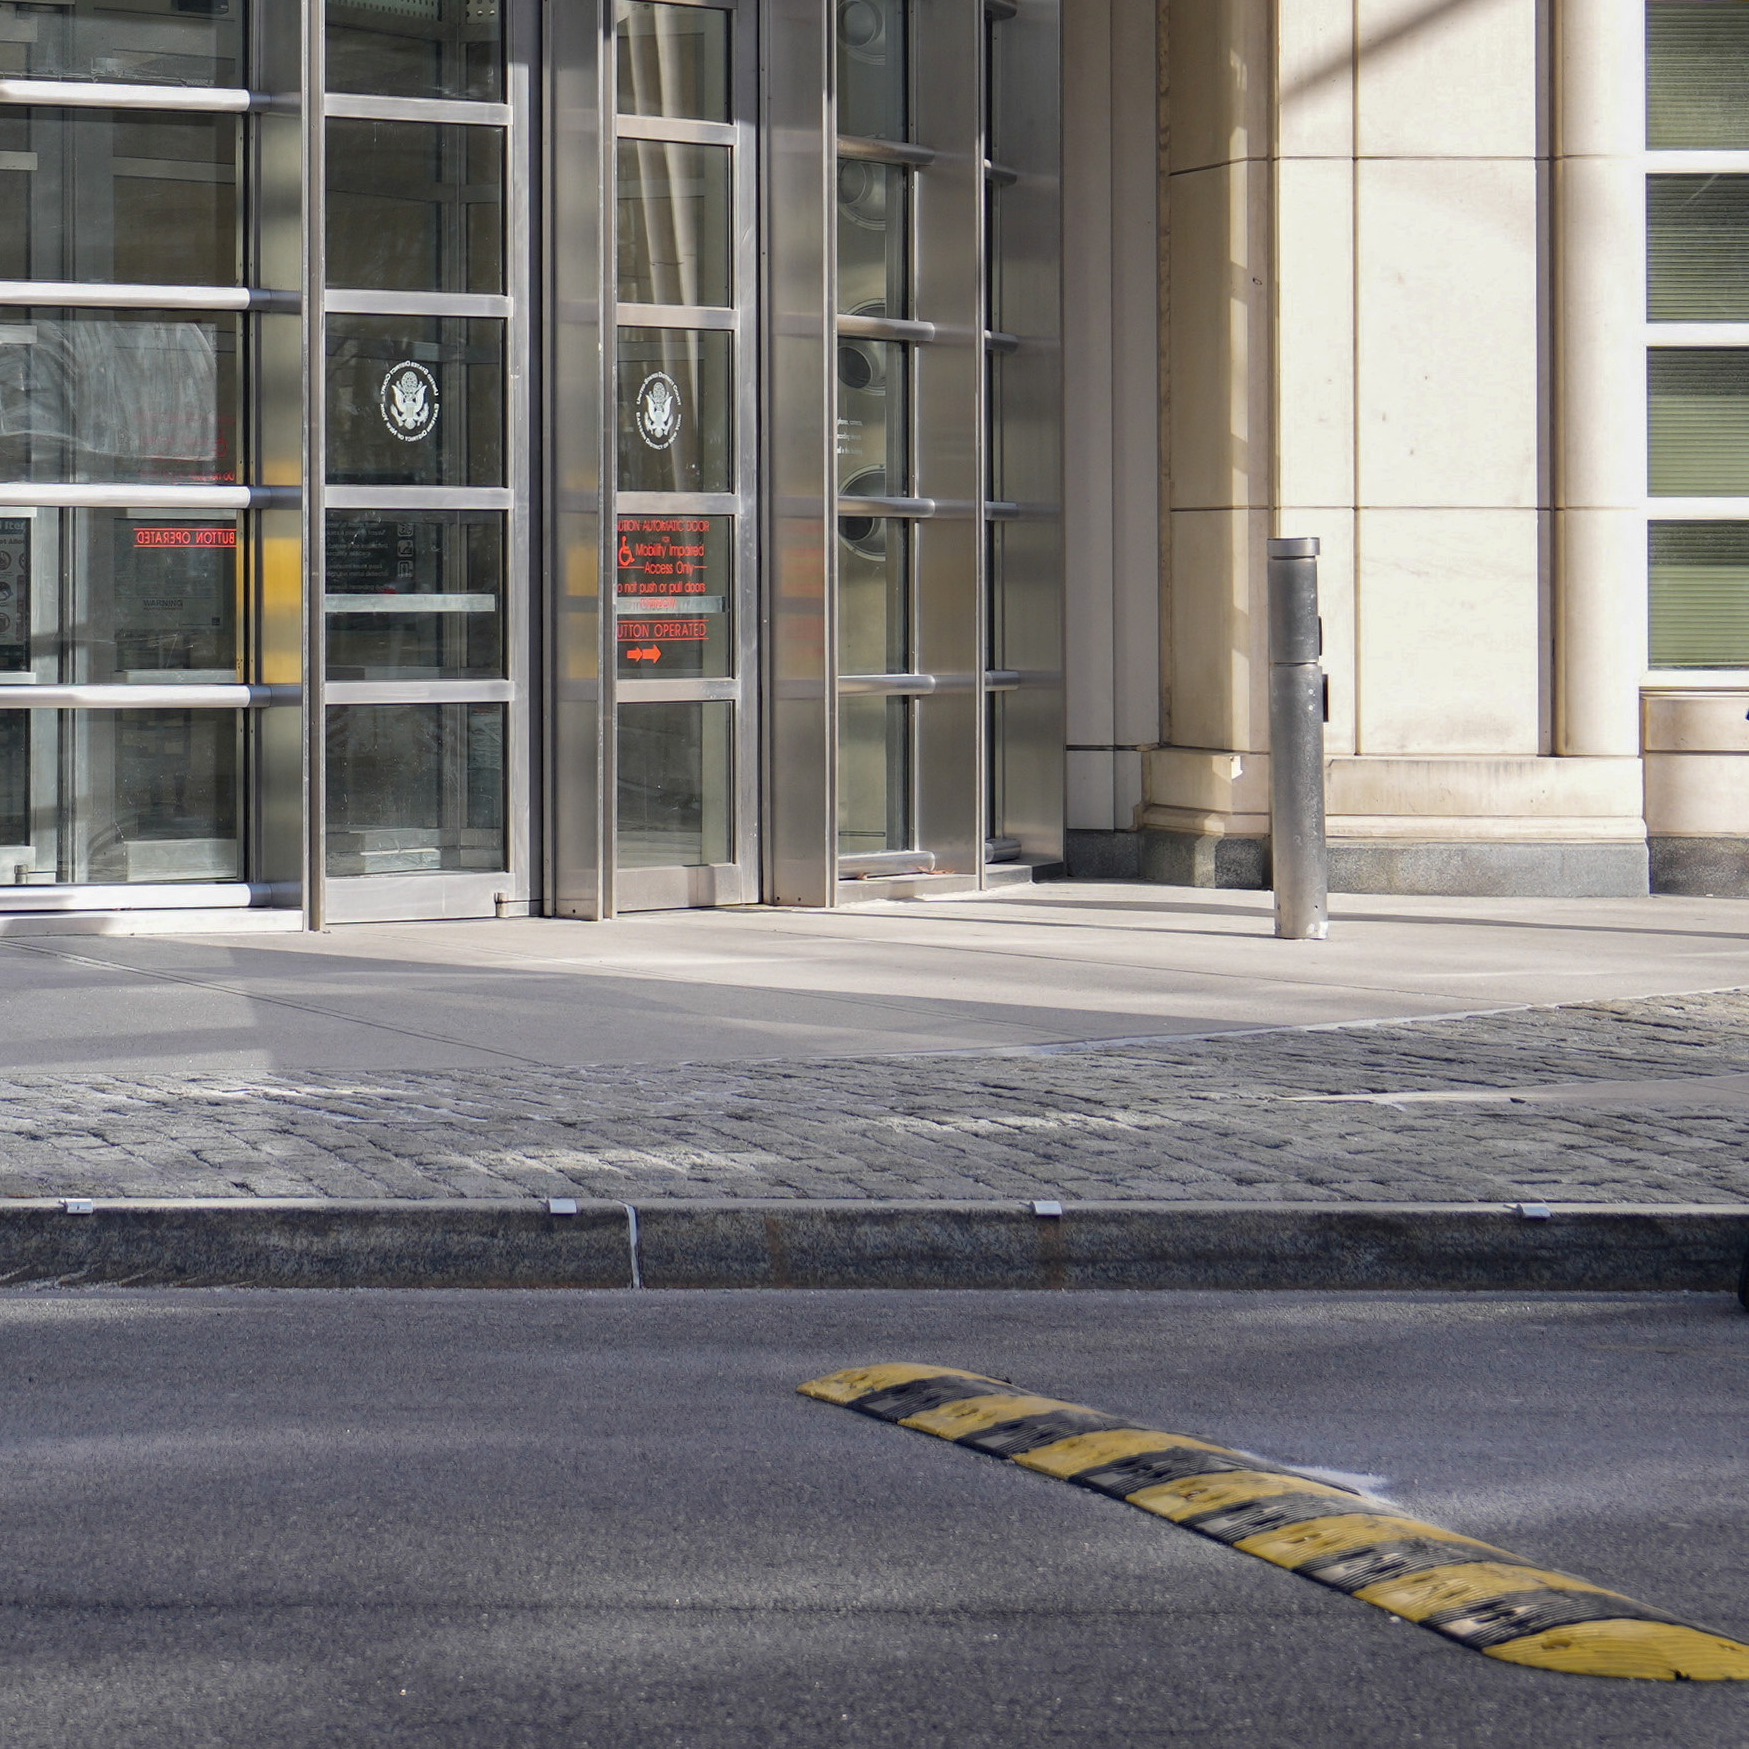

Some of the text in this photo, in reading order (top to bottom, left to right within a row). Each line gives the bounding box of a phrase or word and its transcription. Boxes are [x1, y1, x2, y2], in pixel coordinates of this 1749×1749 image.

[617, 520, 710, 531] UTION AUTOMATIC DOOR
[635, 543, 705, 559] Mobility Impaired
[644, 561, 694, 577] Access Only
[624, 582, 637, 593] not
[639, 582, 657, 594] push
[658, 584, 667, 593] or
[668, 581, 683, 595] pull
[684, 582, 706, 593] doors
[617, 623, 707, 638] UTTON OPERATED
